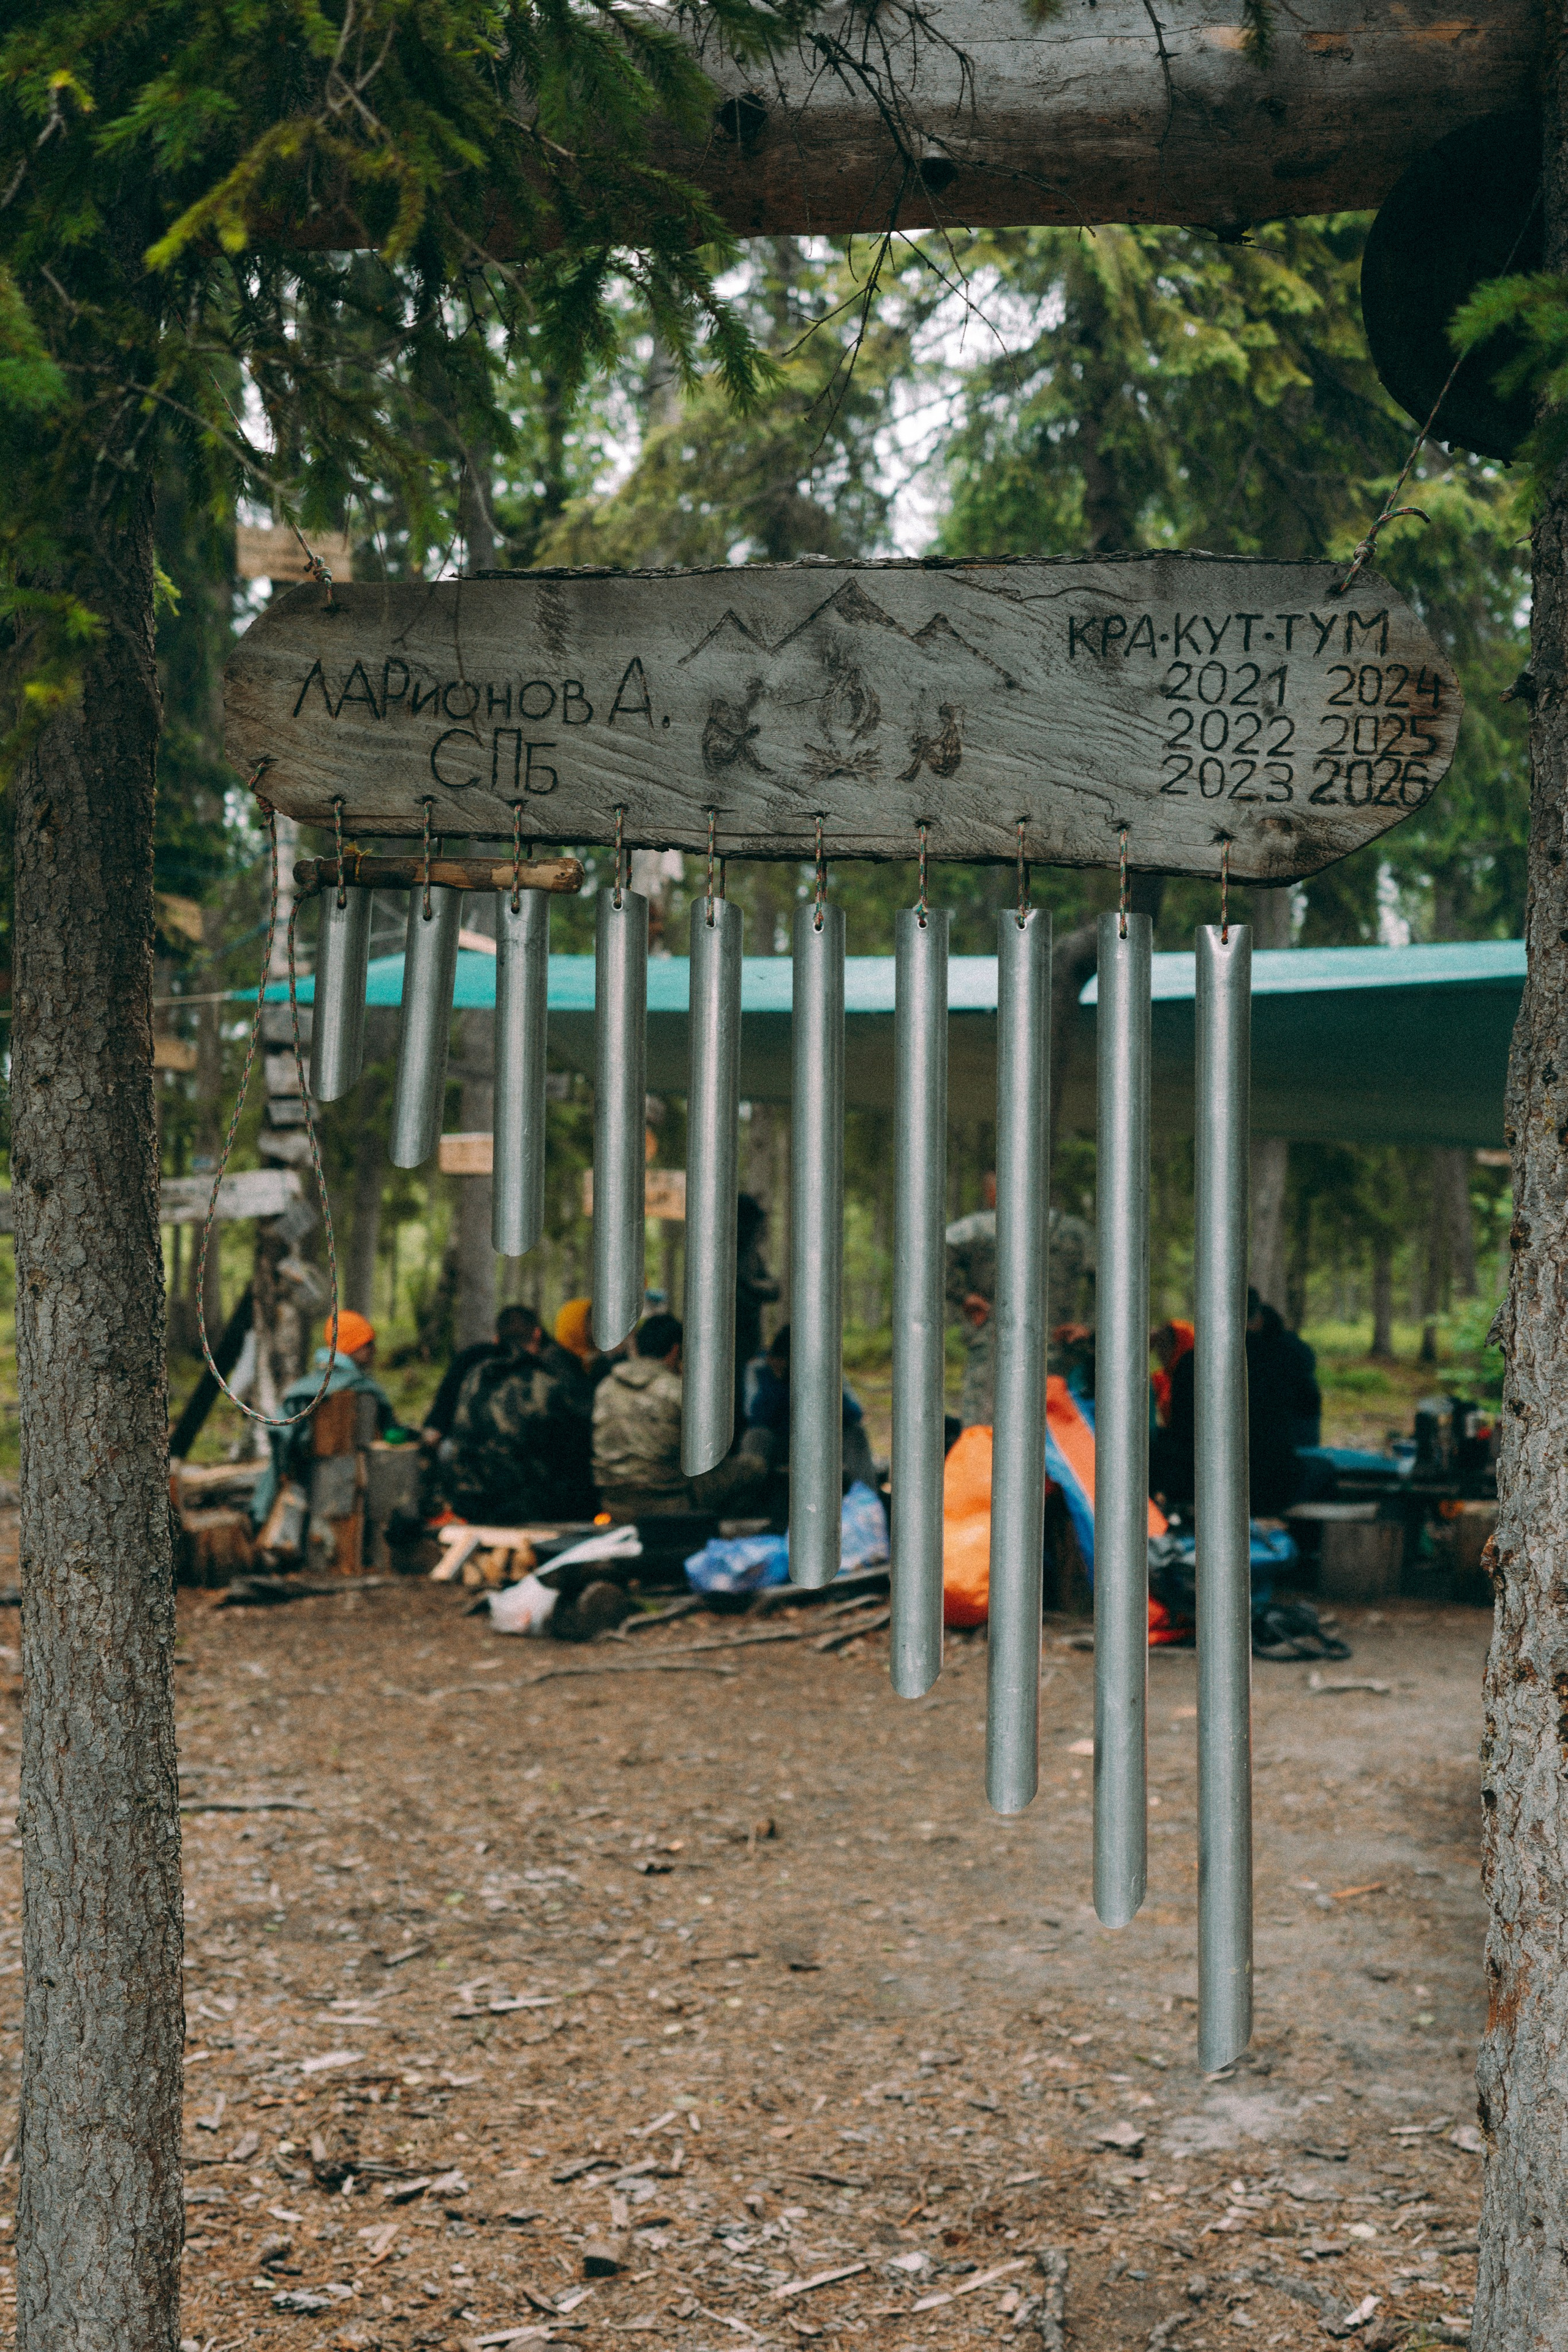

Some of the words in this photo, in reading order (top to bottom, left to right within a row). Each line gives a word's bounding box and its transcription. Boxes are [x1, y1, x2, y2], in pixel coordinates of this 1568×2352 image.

[608, 654, 671, 731] А.
[1164, 660, 1289, 708] 2021
[1325, 662, 1442, 710] 2024
[1165, 707, 1297, 758] 2022
[1317, 712, 1439, 758] 2025
[429, 726, 558, 796] СПБ
[1159, 753, 1294, 802] 2023
[1310, 756, 1431, 808] 2026
